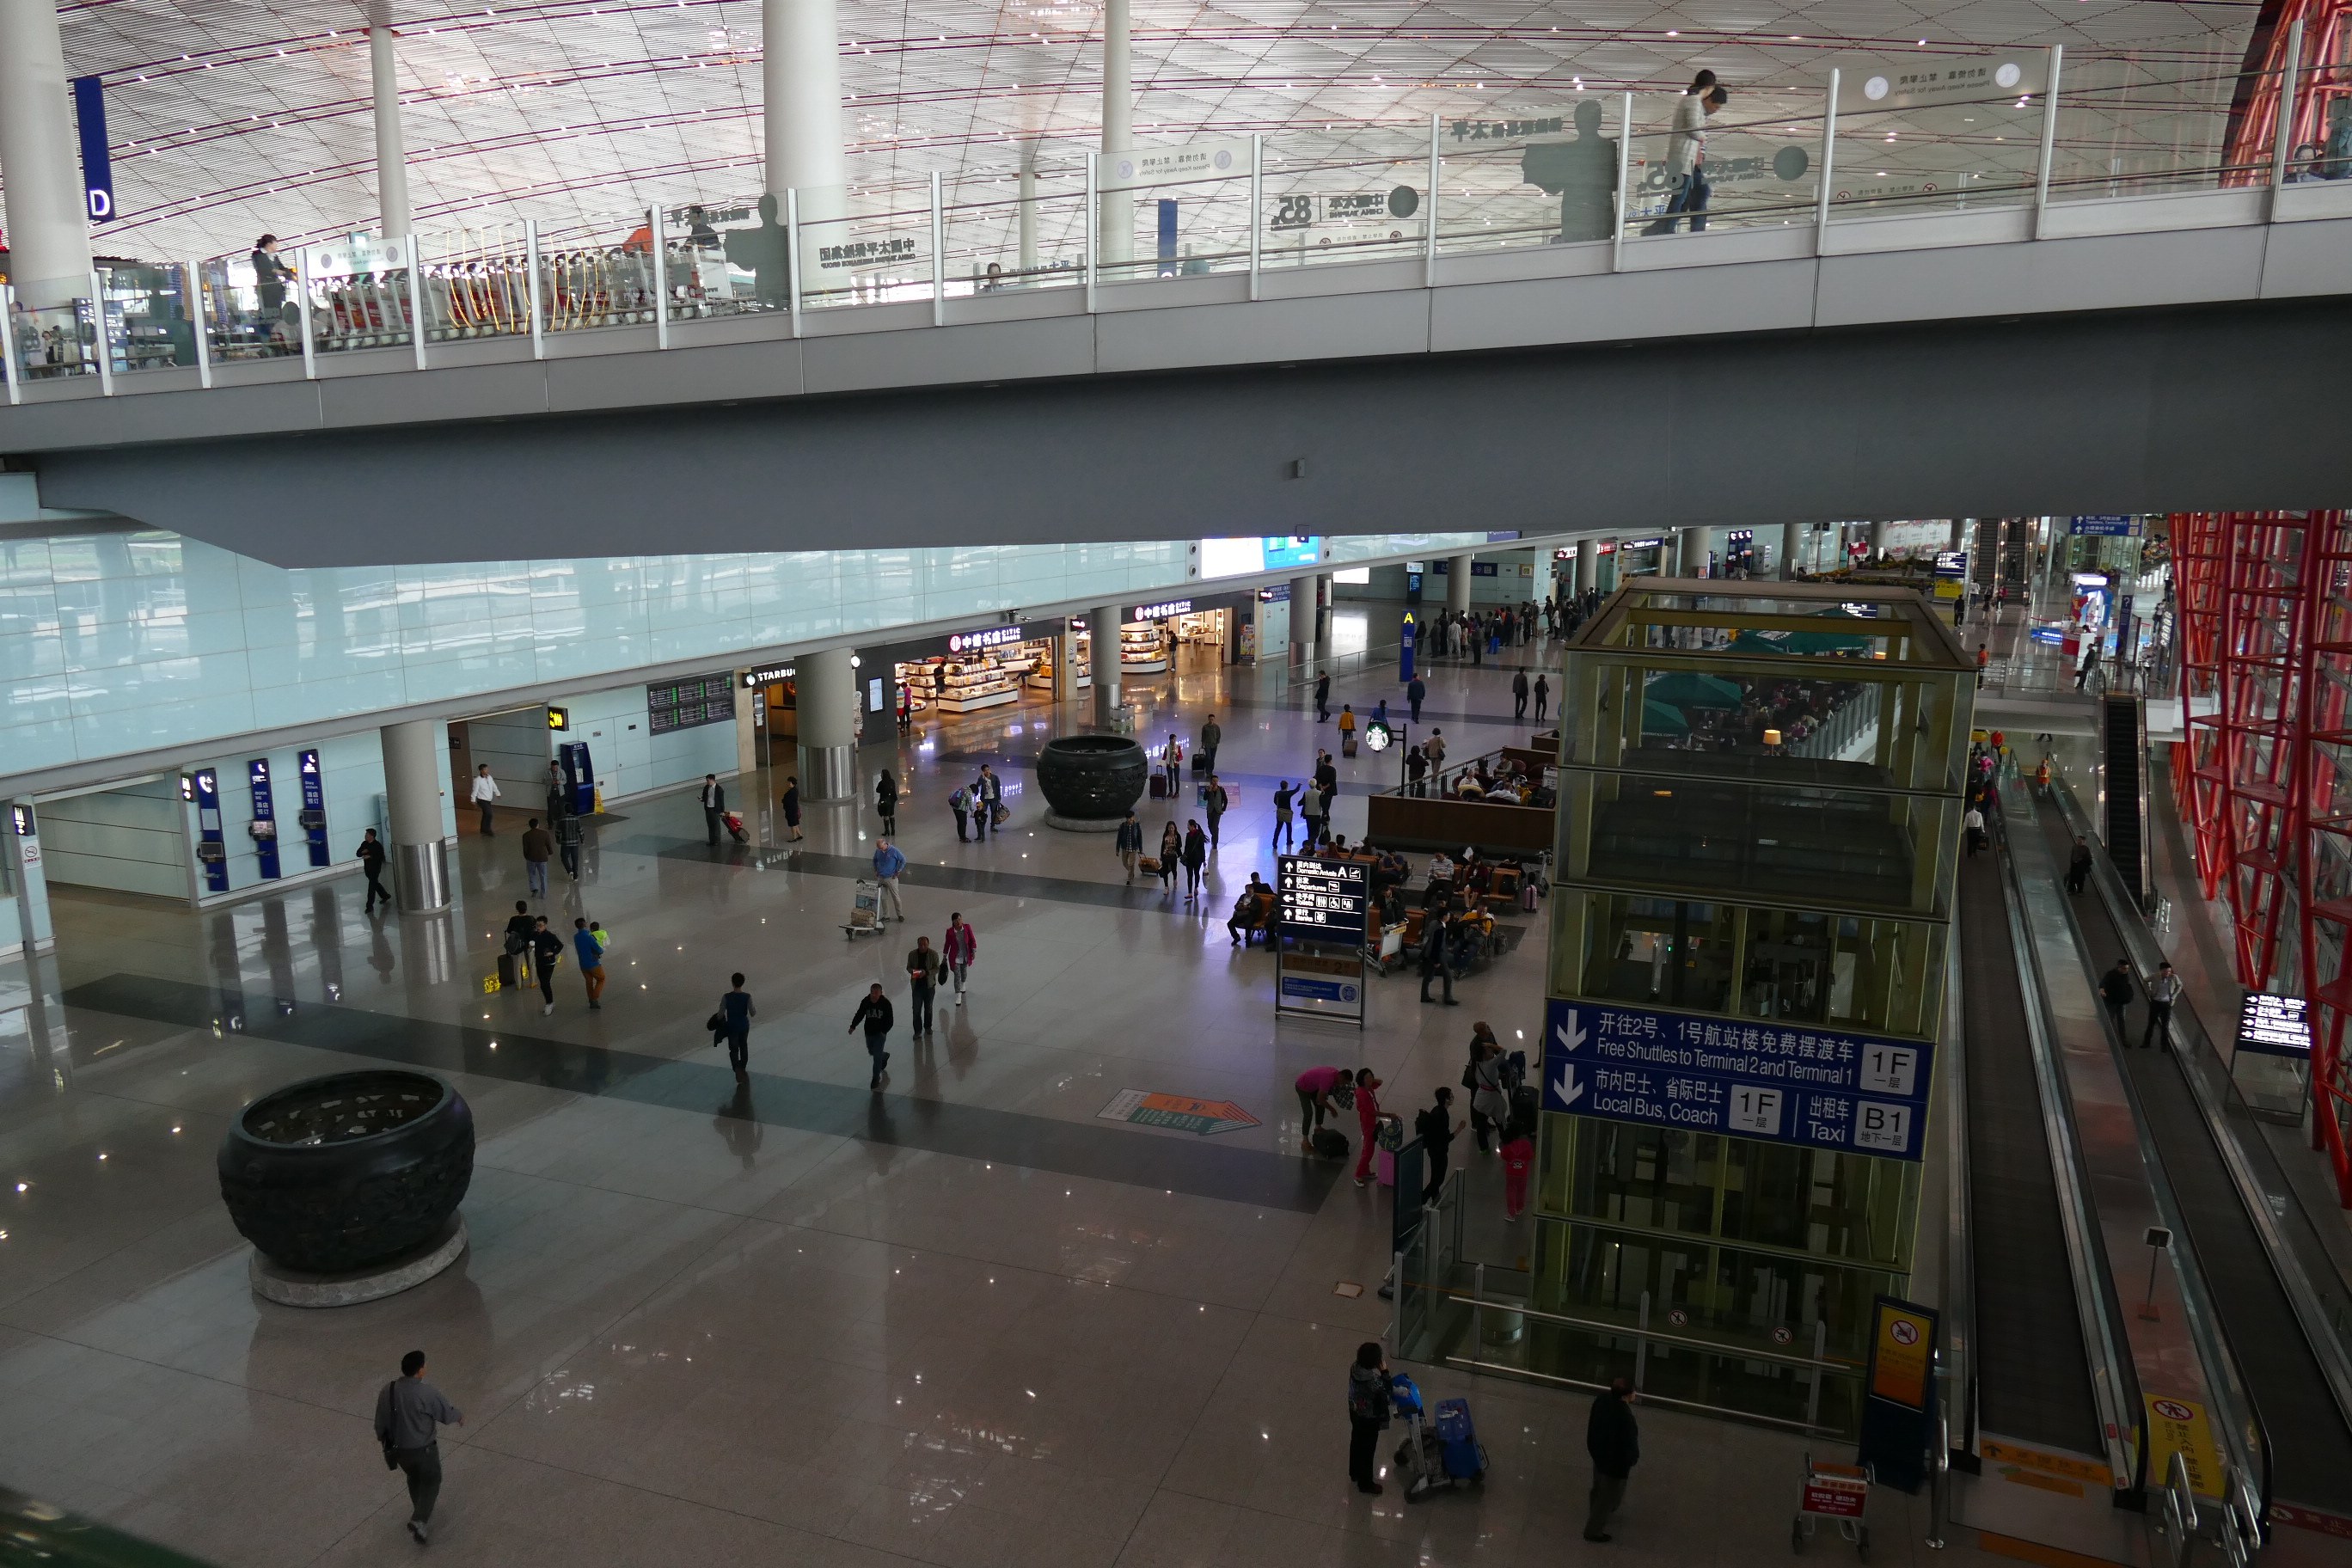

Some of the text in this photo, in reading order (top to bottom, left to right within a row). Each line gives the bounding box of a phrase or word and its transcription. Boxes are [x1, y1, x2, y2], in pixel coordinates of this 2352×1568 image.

[89, 189, 111, 217] D
[1403, 611, 1415, 624] A
[1001, 627, 1021, 638] CITIC
[1296, 861, 1322, 870] 国内到达
[1338, 866, 1347, 878] A
[1295, 876, 1309, 885] 出发
[1295, 883, 1327, 892] Departures
[1598, 1012, 1854, 1063] 开往2号、1号航站楼免费摆渡车
[1597, 1037, 1853, 1086] Free Shuttles to Terminal 2 and Terminal 1
[1872, 1050, 1910, 1075] 1F
[1596, 1068, 1723, 1105] 市内巴士、省际巴士
[1874, 1076, 1901, 1089] 一层
[1593, 1092, 1718, 1125] Local Bus, Coach
[1739, 1092, 1776, 1115] 1F
[1809, 1094, 1850, 1122] 出租车
[1742, 1117, 1767, 1129] 一层
[1807, 1119, 1847, 1143] Taxi
[1865, 1106, 1901, 1133] B1
[1860, 1130, 1902, 1147] 地下一层
